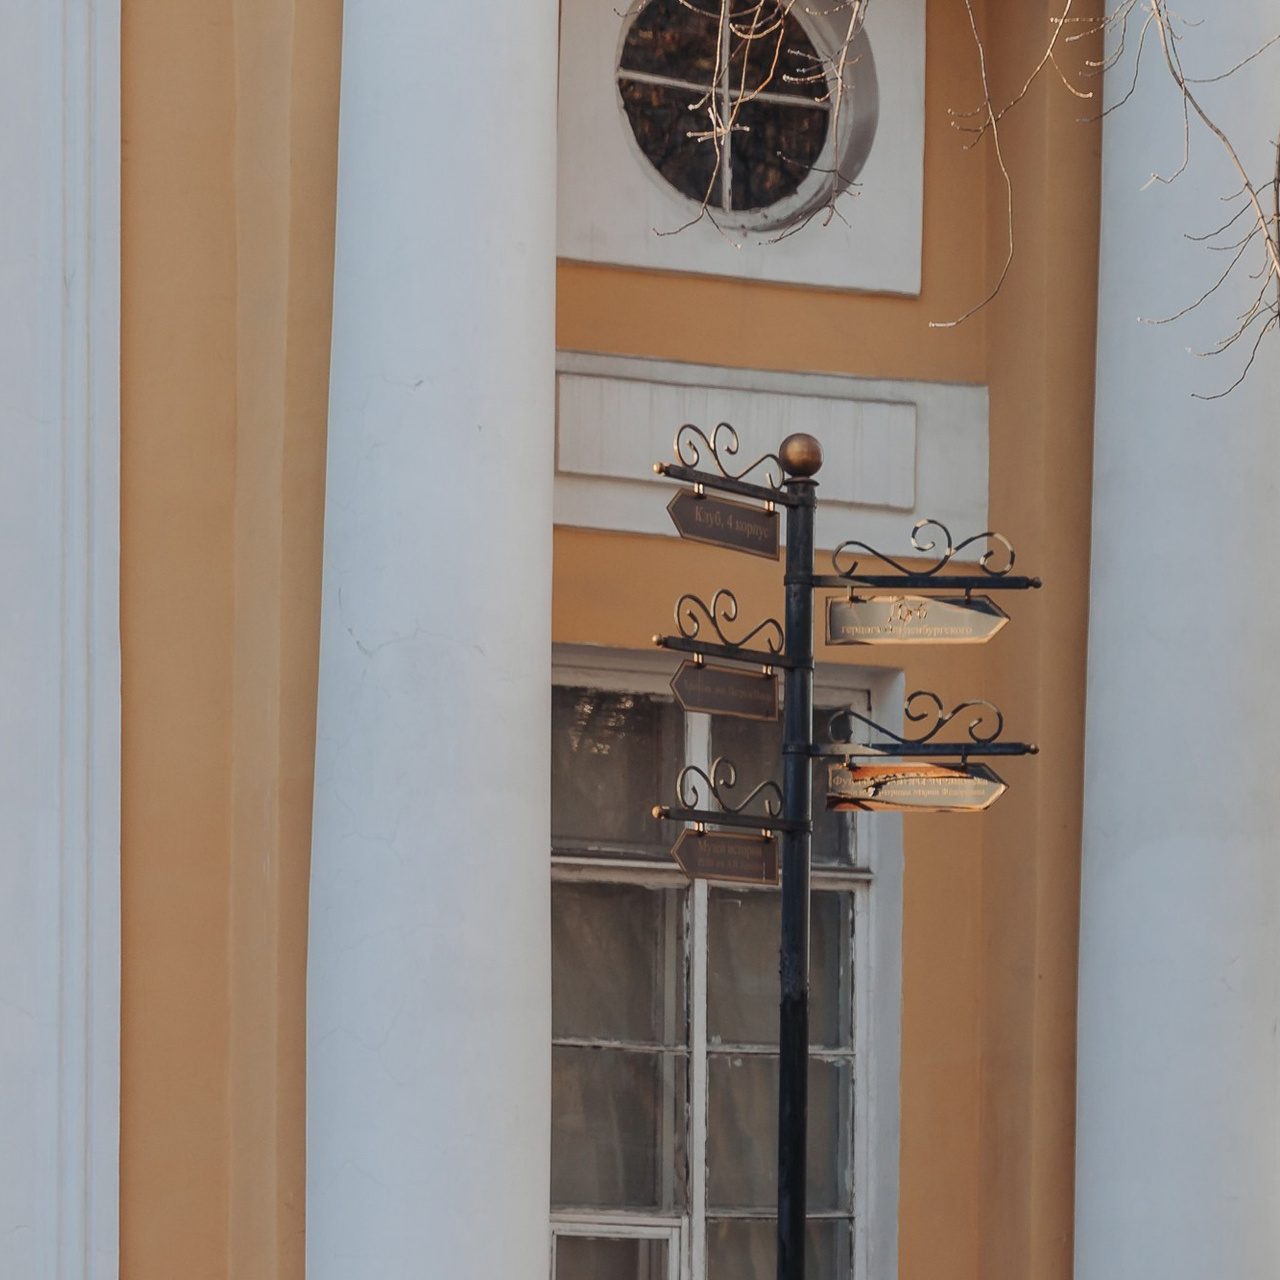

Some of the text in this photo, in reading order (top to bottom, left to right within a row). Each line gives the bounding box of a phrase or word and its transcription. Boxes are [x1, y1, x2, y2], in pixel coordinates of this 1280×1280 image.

[695, 505, 769, 542] Клуб, 4 корпус
